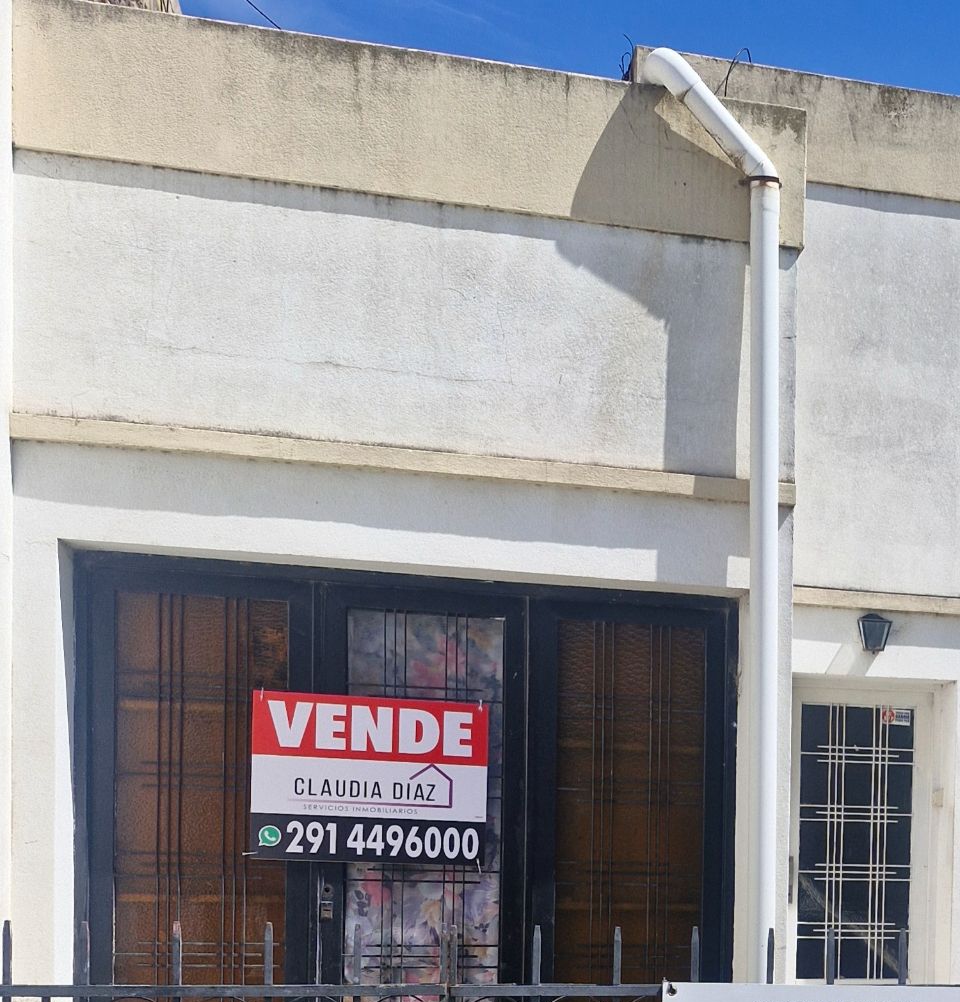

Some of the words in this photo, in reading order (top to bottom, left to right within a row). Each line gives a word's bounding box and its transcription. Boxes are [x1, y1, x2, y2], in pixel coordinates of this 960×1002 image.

[267, 700, 473, 757] VENDE
[294, 777, 382, 799] CLAUDIA
[392, 782, 436, 802] DIAZ
[303, 803, 349, 812] SERVICIOS
[352, 806, 418, 815] INMOBILIARIOS
[285, 820, 338, 855] 291
[346, 823, 480, 860] 4496000
